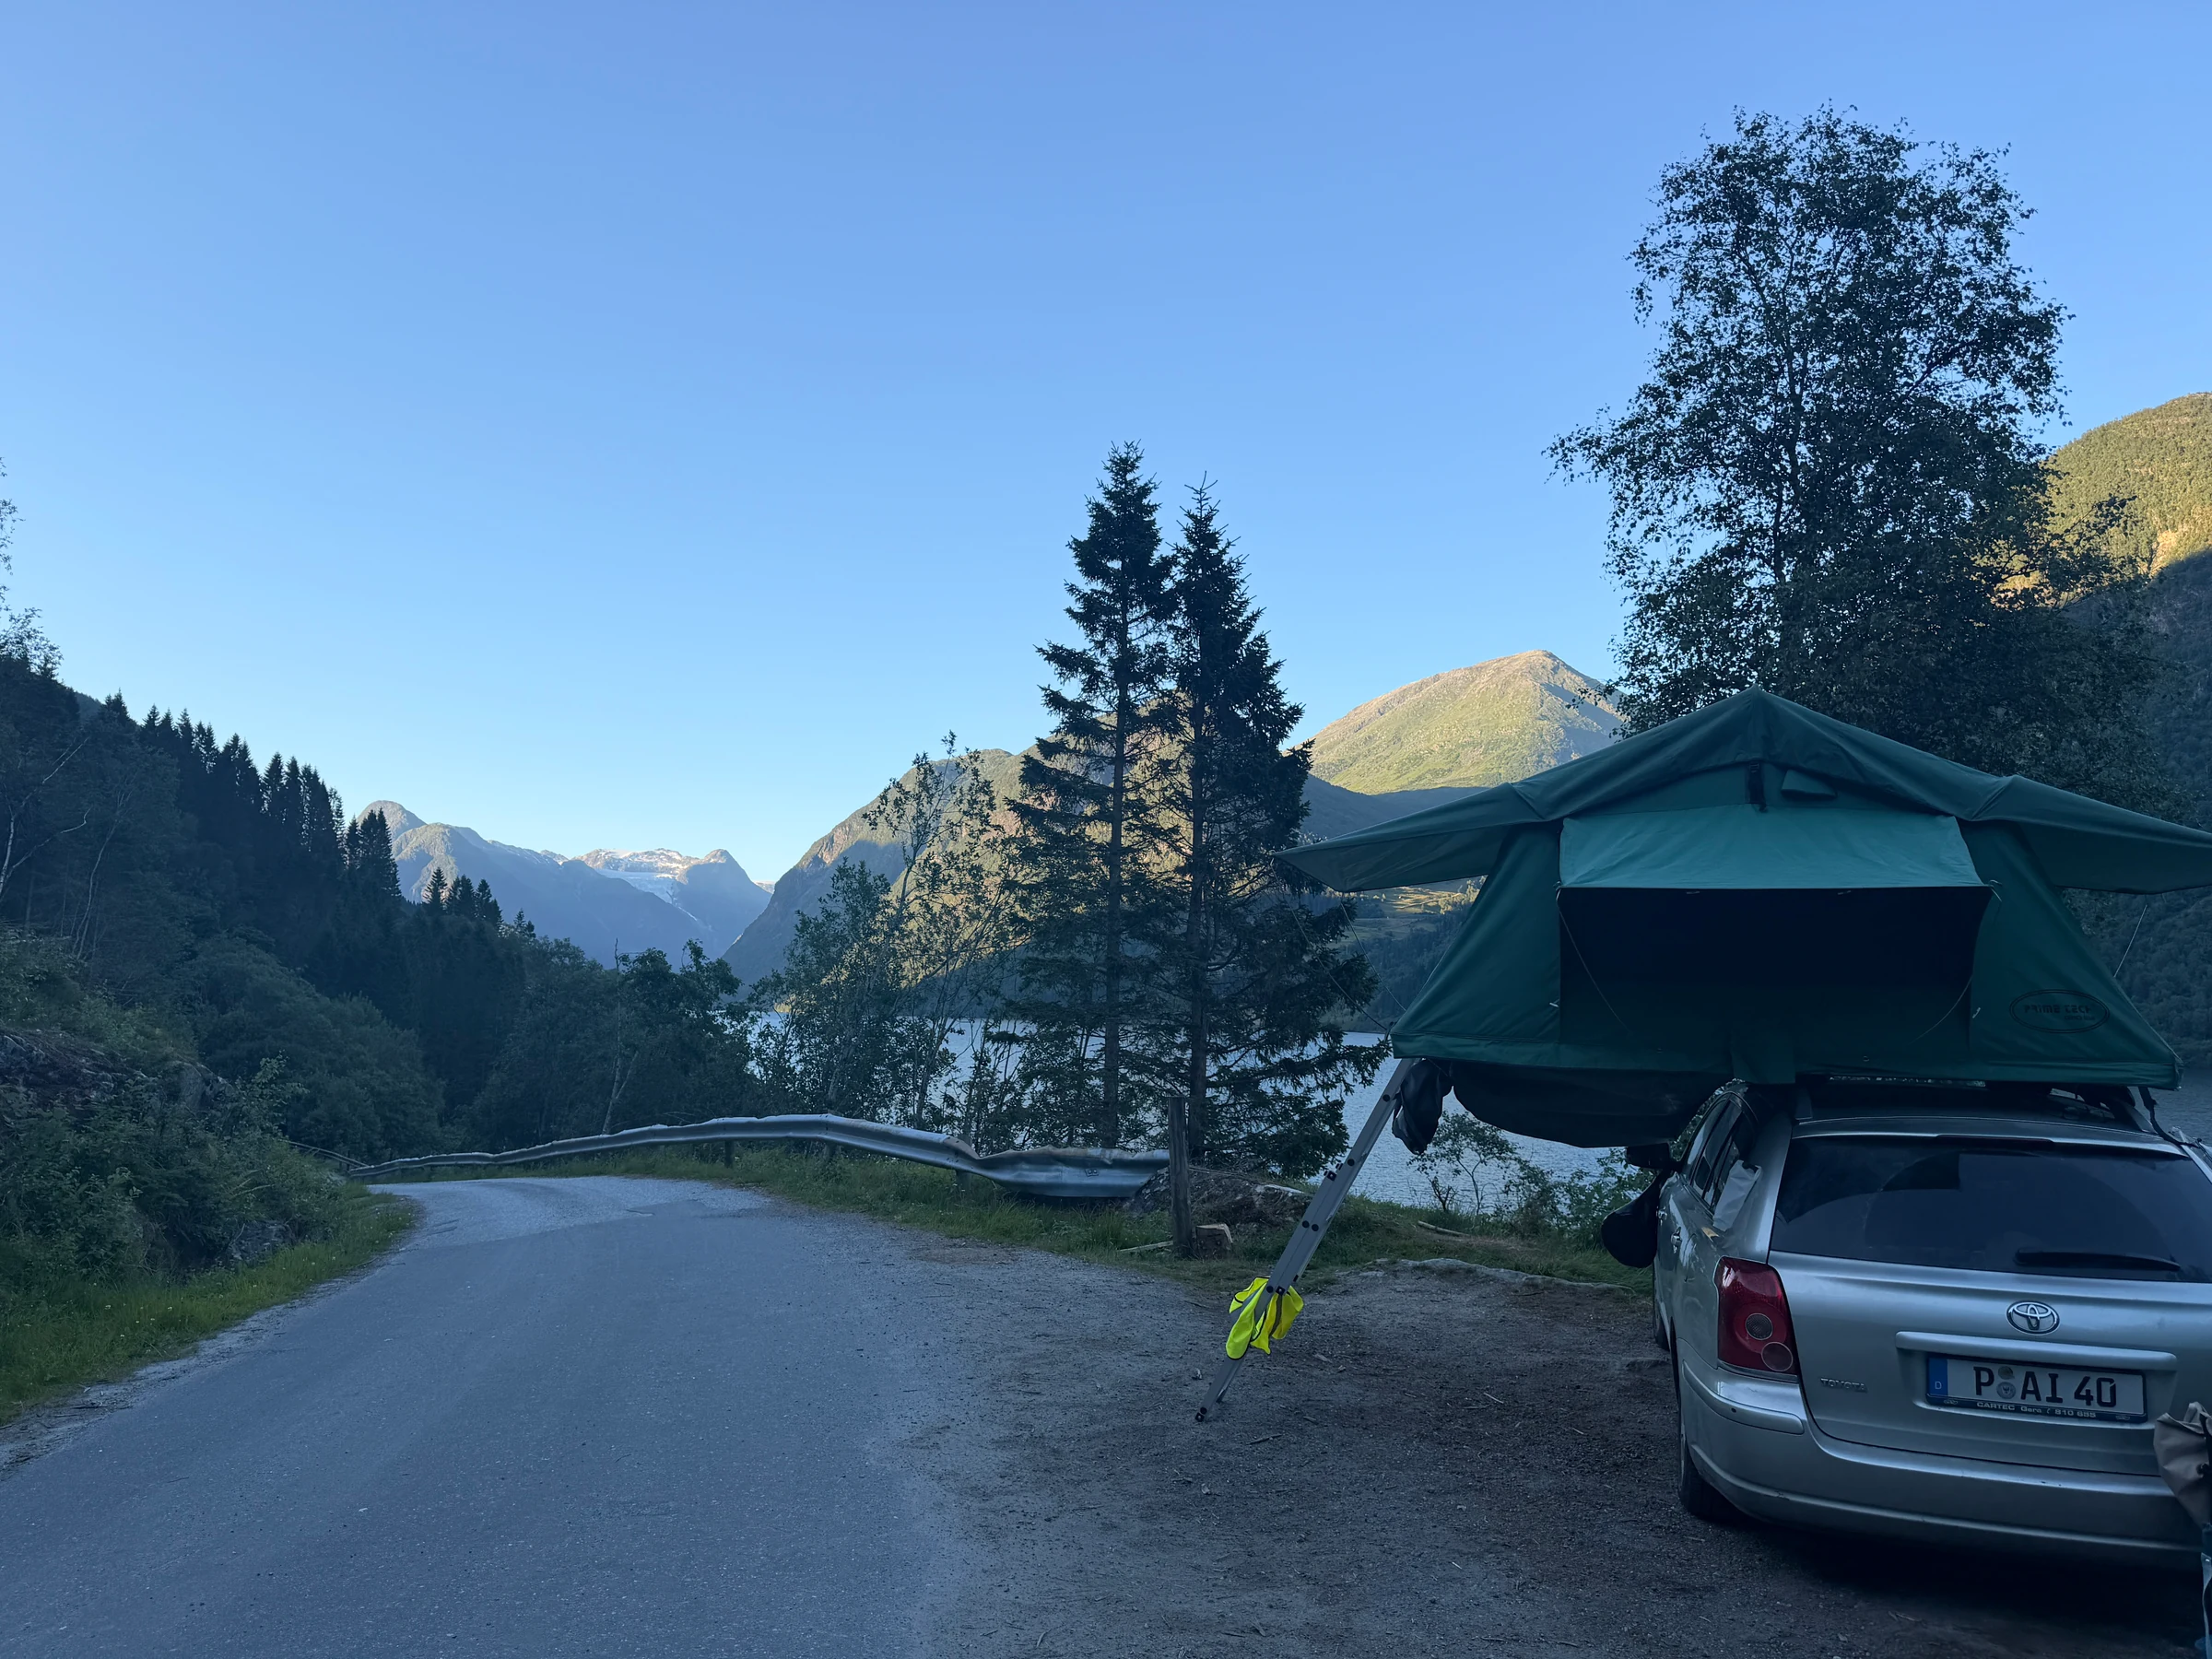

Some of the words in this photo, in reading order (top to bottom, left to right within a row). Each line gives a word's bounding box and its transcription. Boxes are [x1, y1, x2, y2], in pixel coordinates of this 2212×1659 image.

[1820, 1378, 1867, 1392] TOYOTA
[1935, 1381, 1942, 1390] D
[1973, 1366, 1994, 1396] P
[2020, 1371, 2064, 1404] AI
[2074, 1376, 2117, 1407] 40
[1976, 1402, 2016, 1411] CARTEC
